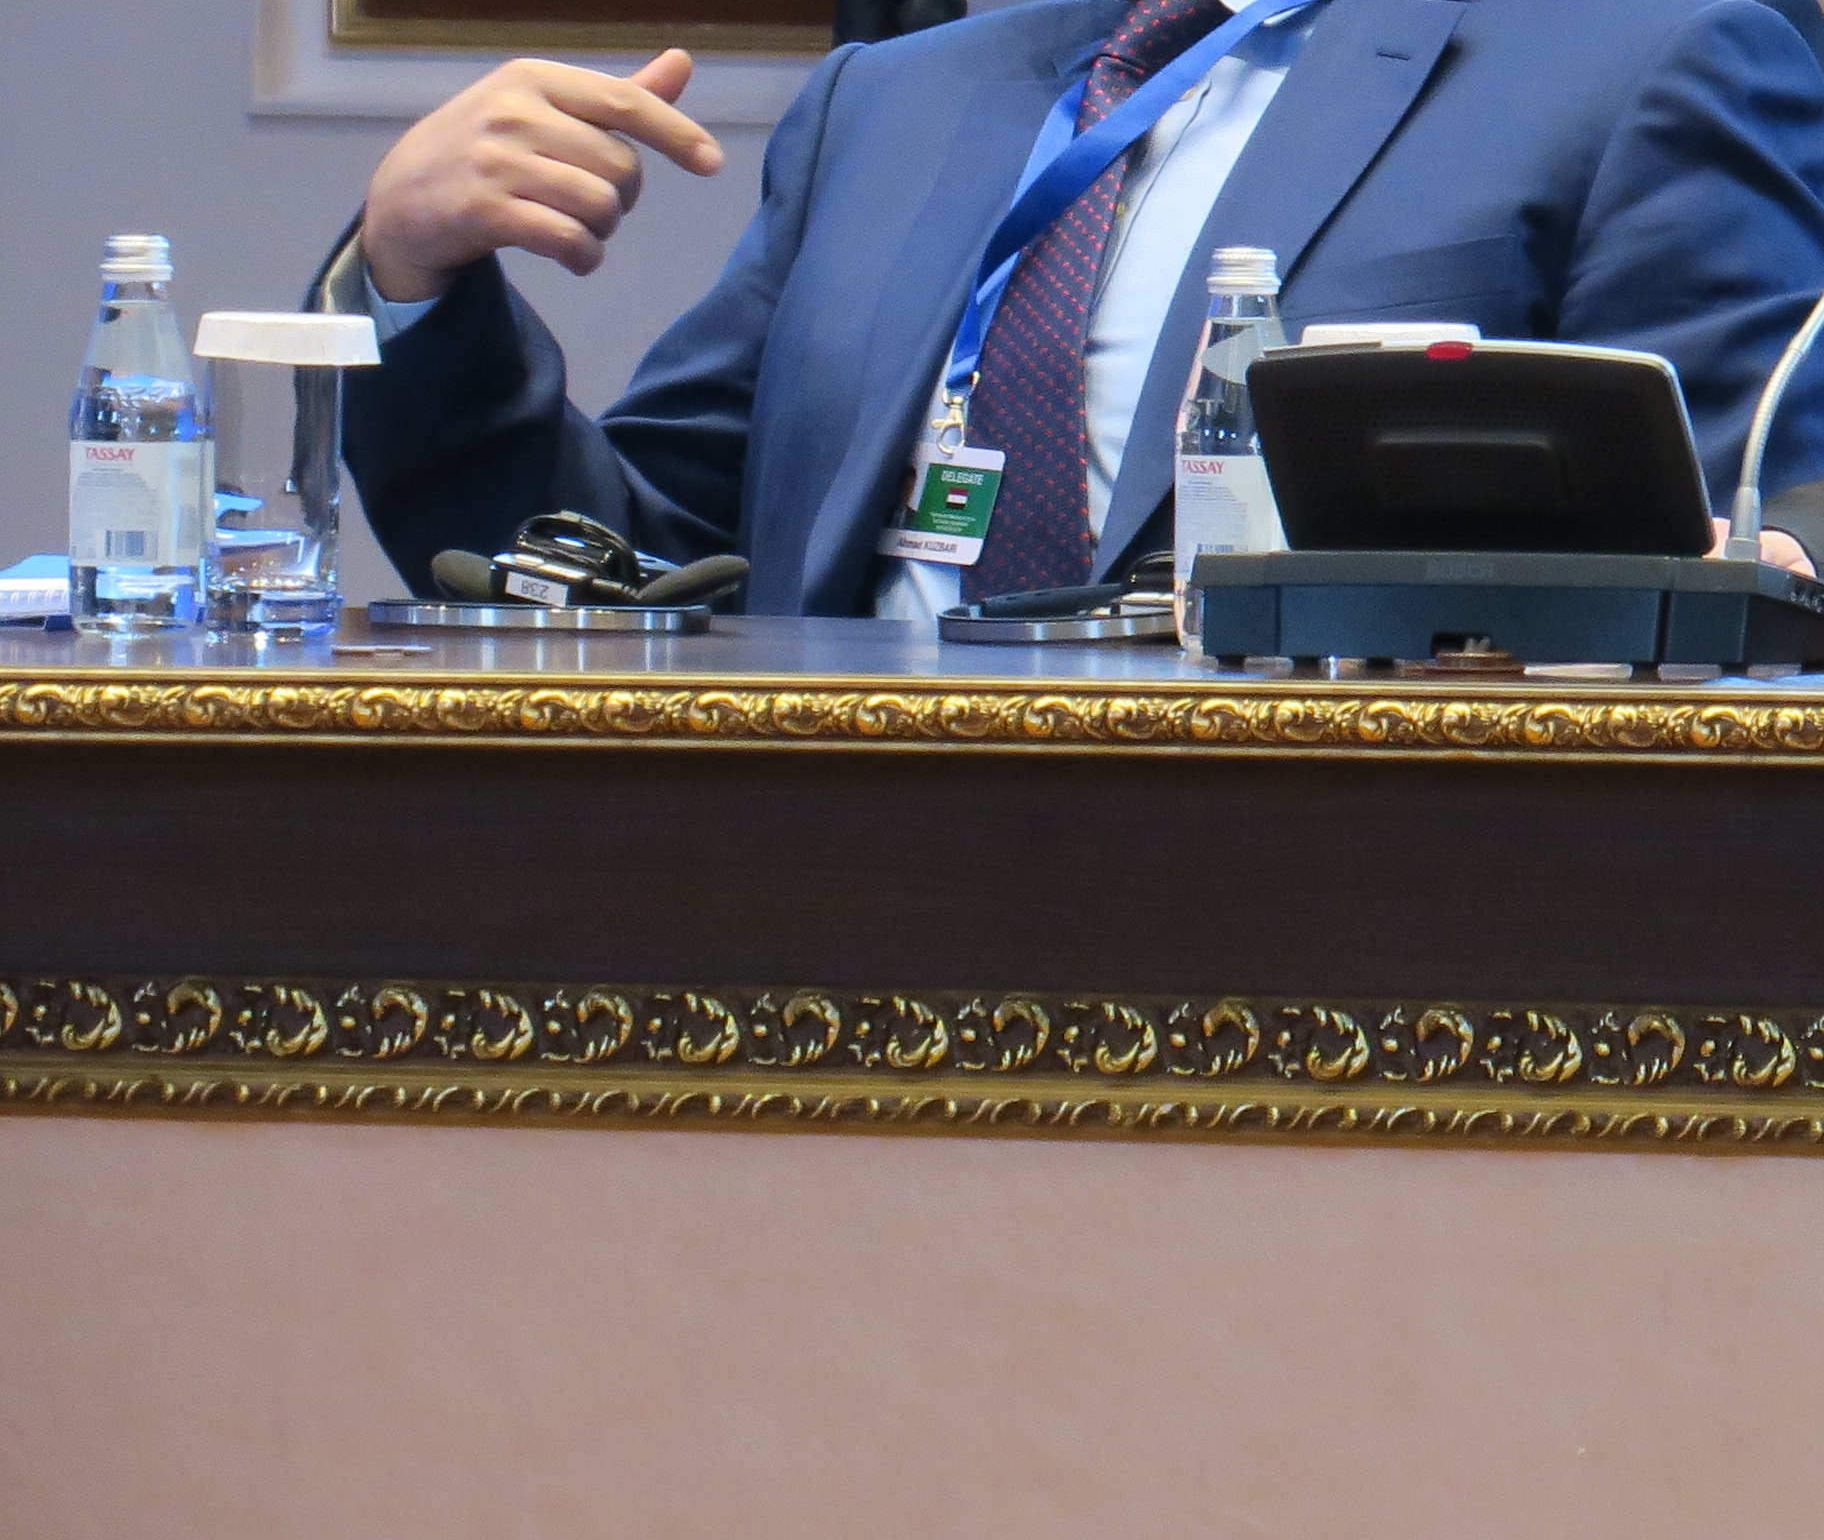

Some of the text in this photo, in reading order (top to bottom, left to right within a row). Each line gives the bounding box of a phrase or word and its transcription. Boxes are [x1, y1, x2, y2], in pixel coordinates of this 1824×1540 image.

[85, 447, 136, 461] TASSAY
[1182, 460, 1225, 474] TASSAY
[940, 470, 984, 486] DELEGATE
[521, 578, 549, 600] 238
